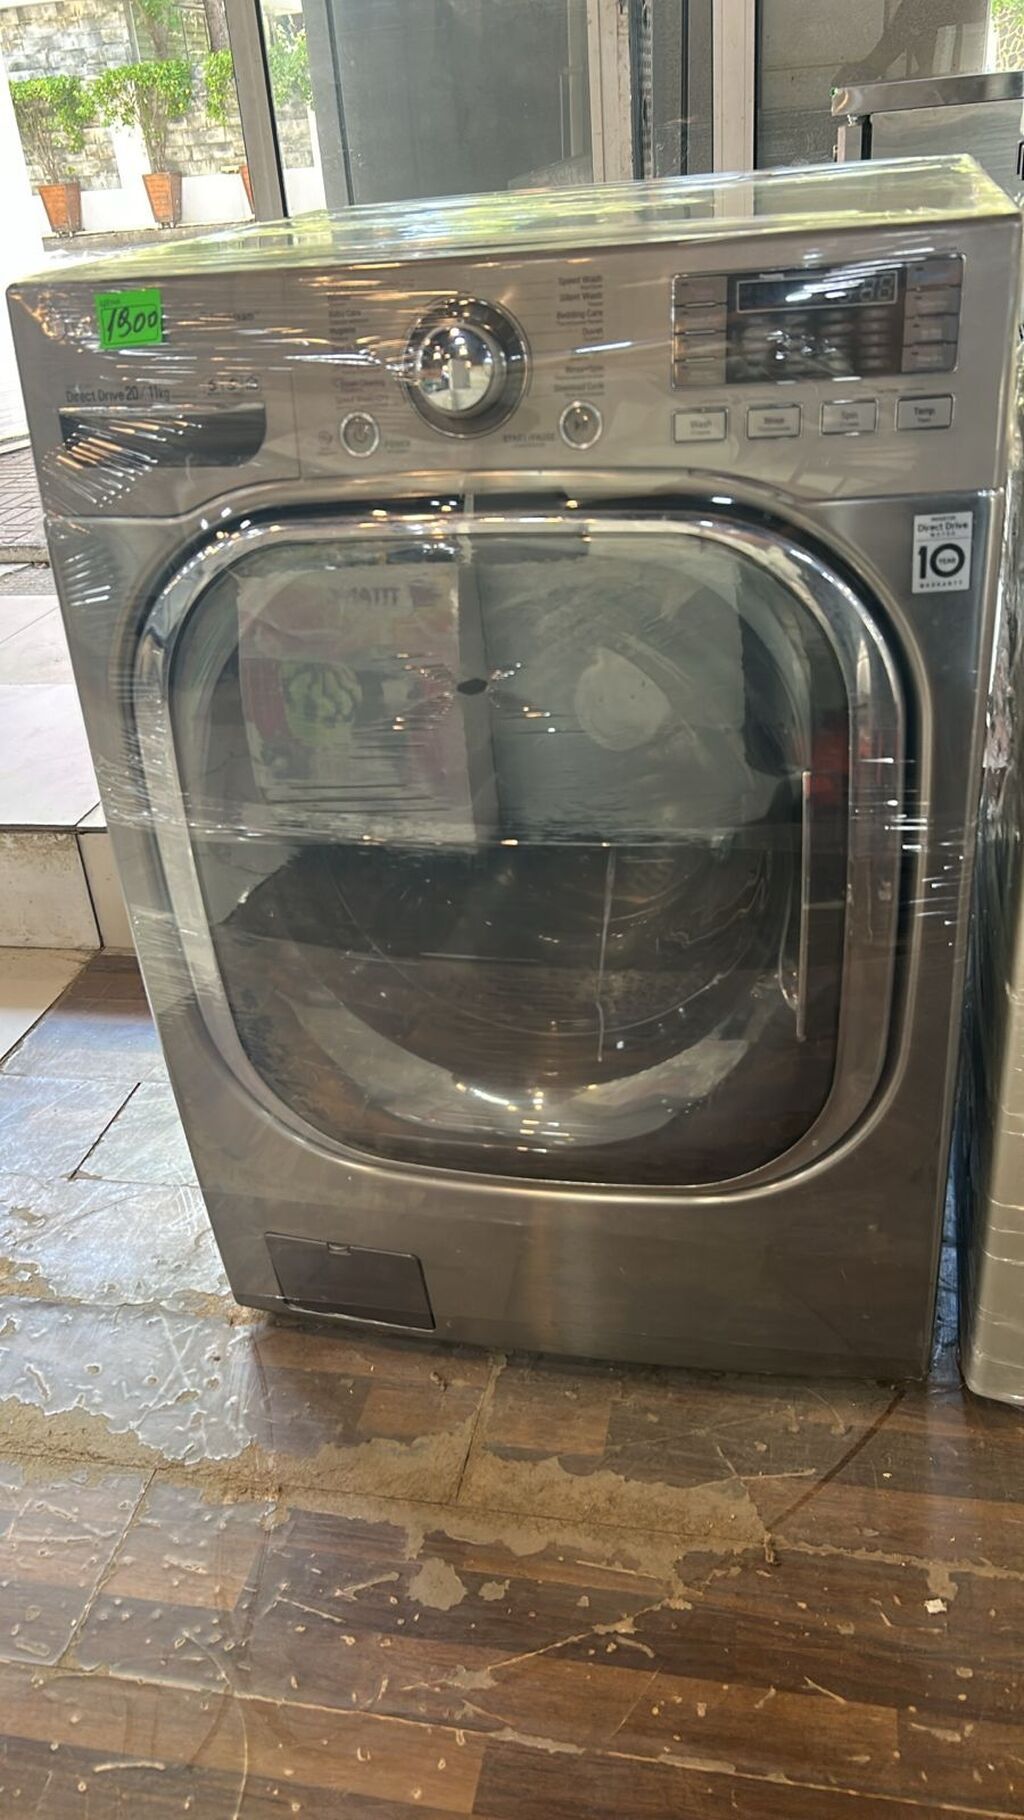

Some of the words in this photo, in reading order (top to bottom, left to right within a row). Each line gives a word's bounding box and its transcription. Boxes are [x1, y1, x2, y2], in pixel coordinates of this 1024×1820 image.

[97, 388, 125, 402] Drive
[125, 385, 139, 401] 20
[917, 524, 943, 533] Direct
[945, 521, 968, 531] Drive
[918, 543, 966, 579] 10
